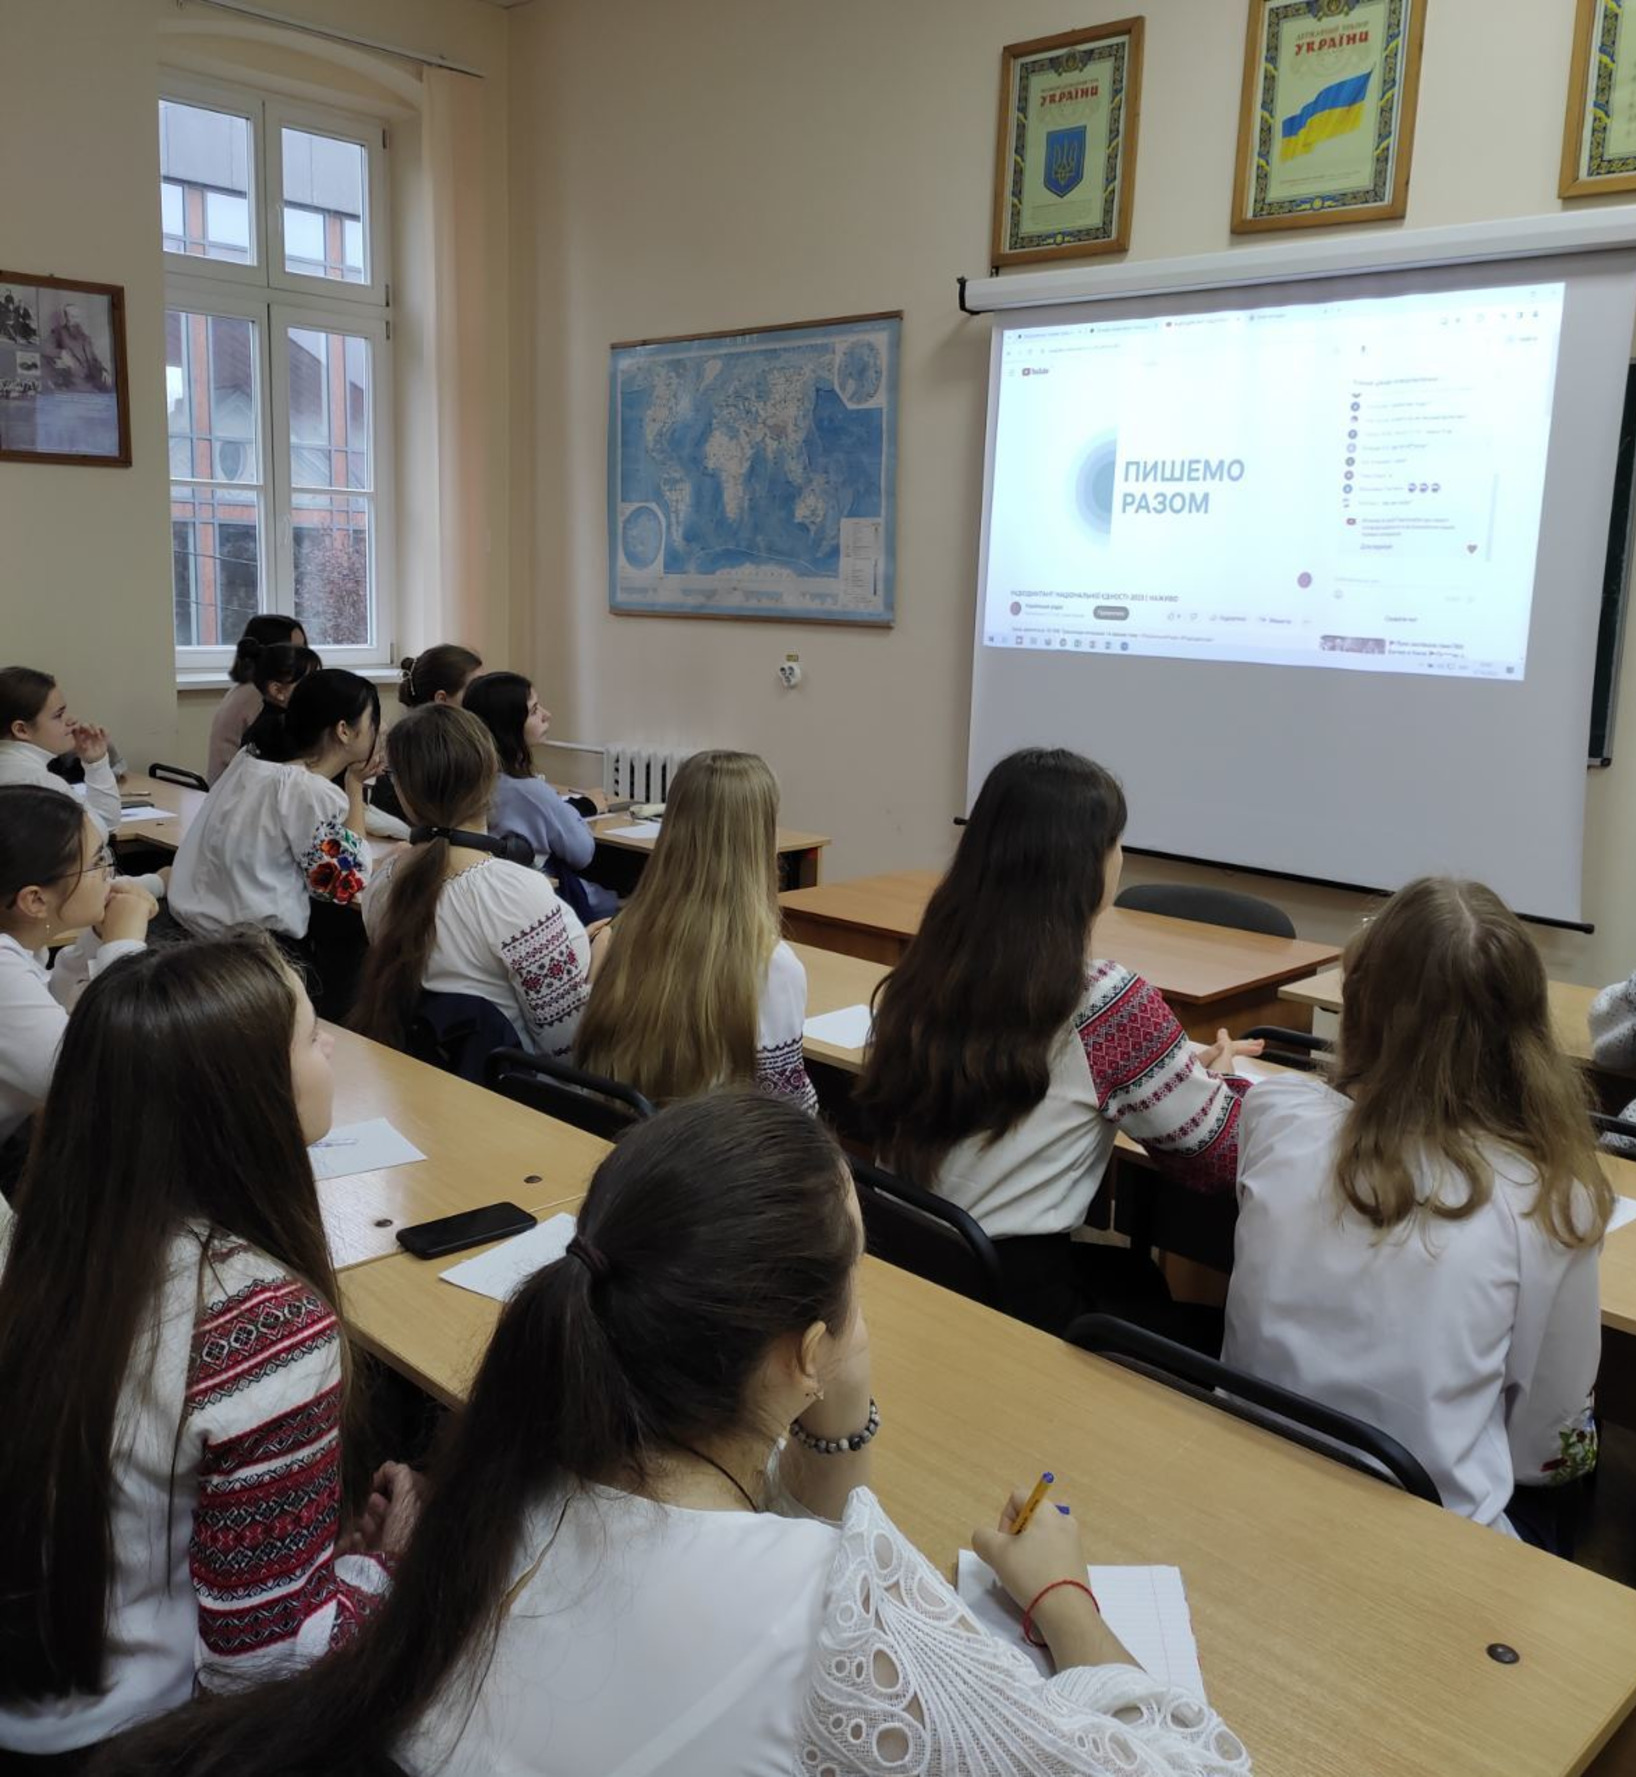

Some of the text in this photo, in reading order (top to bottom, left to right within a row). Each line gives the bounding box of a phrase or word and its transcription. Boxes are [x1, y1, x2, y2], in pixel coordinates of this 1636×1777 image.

[1295, 30, 1369, 56] УКРАЇНИ
[1040, 85, 1099, 107] УКРАЇНИ
[1124, 459, 1245, 482] ПИШЕМО
[1122, 492, 1210, 514] РАЗОМ
